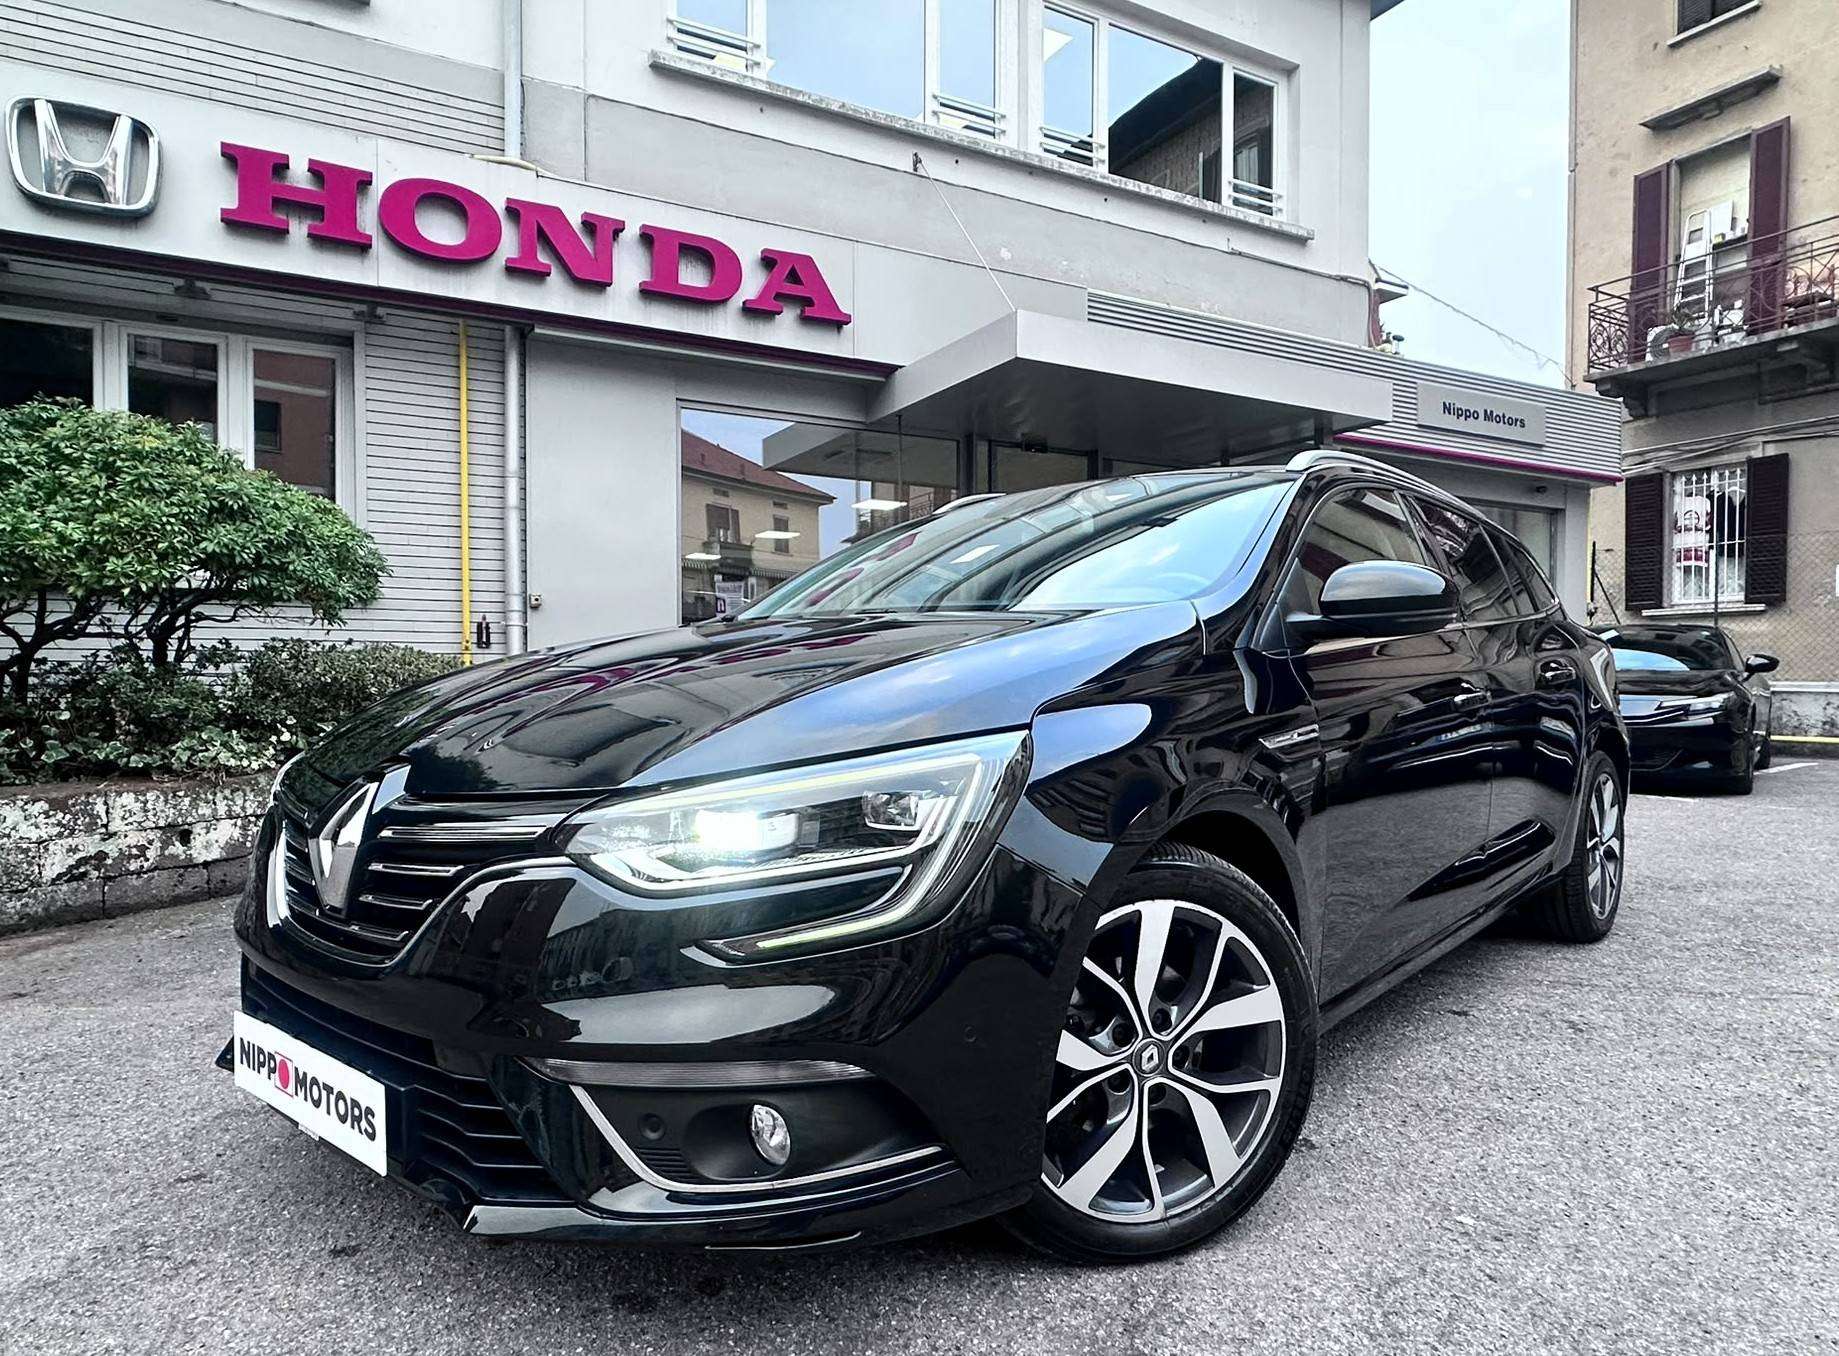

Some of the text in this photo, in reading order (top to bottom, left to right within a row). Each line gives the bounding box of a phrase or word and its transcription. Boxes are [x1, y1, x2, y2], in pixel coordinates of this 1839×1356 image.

[220, 141, 852, 328] HONDA
[1442, 401, 1526, 428] Nippo Motors
[294, 1066, 377, 1142] MOTORS
